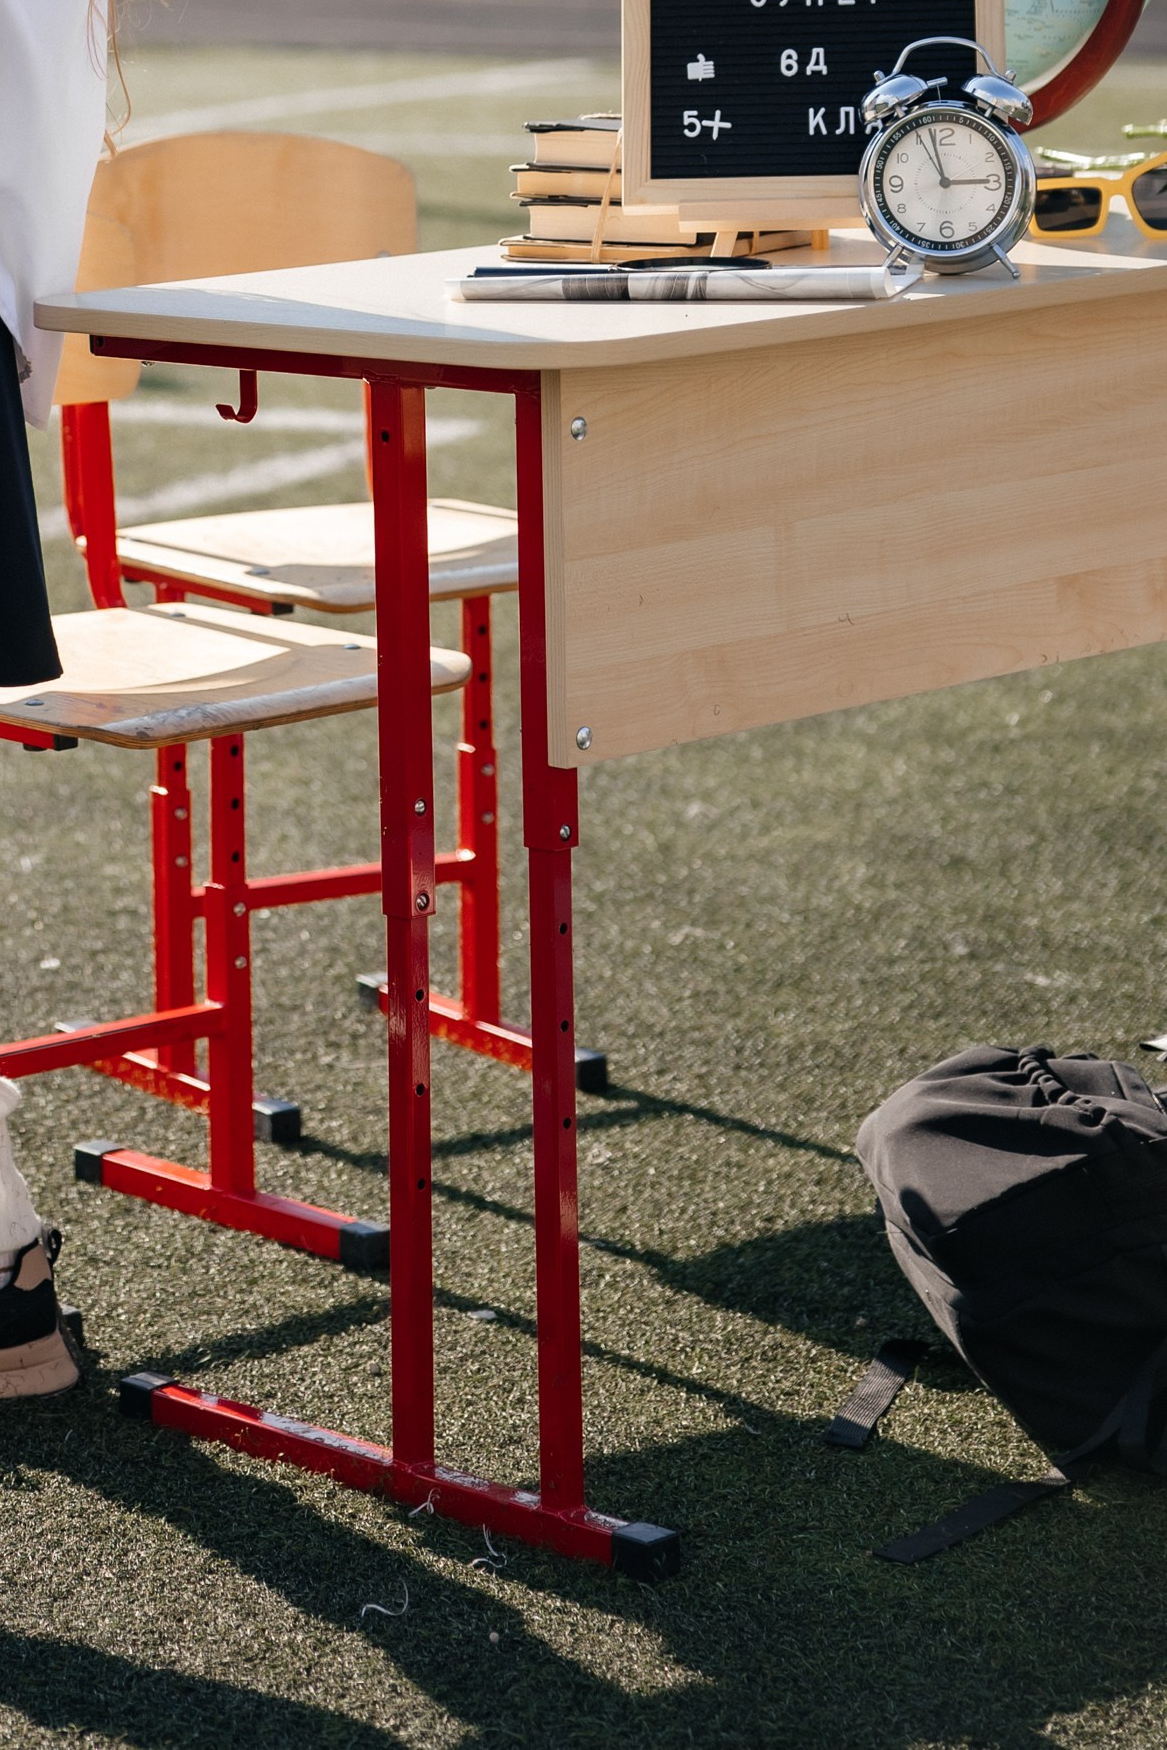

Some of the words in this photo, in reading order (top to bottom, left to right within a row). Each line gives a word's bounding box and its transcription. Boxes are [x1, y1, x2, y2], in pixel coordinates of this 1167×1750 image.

[780, 47, 828, 78] 6Д
[683, 109, 733, 141] 5+
[933, 127, 957, 146] 12
[897, 152, 909, 164] 10
[985, 151, 995, 163] 2
[889, 175, 904, 193] 9
[984, 173, 1002, 191] 3
[897, 203, 907, 214] 8
[985, 203, 996, 214] 4
[916, 222, 926, 232] 7
[939, 220, 955, 239] 6
[968, 221, 978, 232] 5
